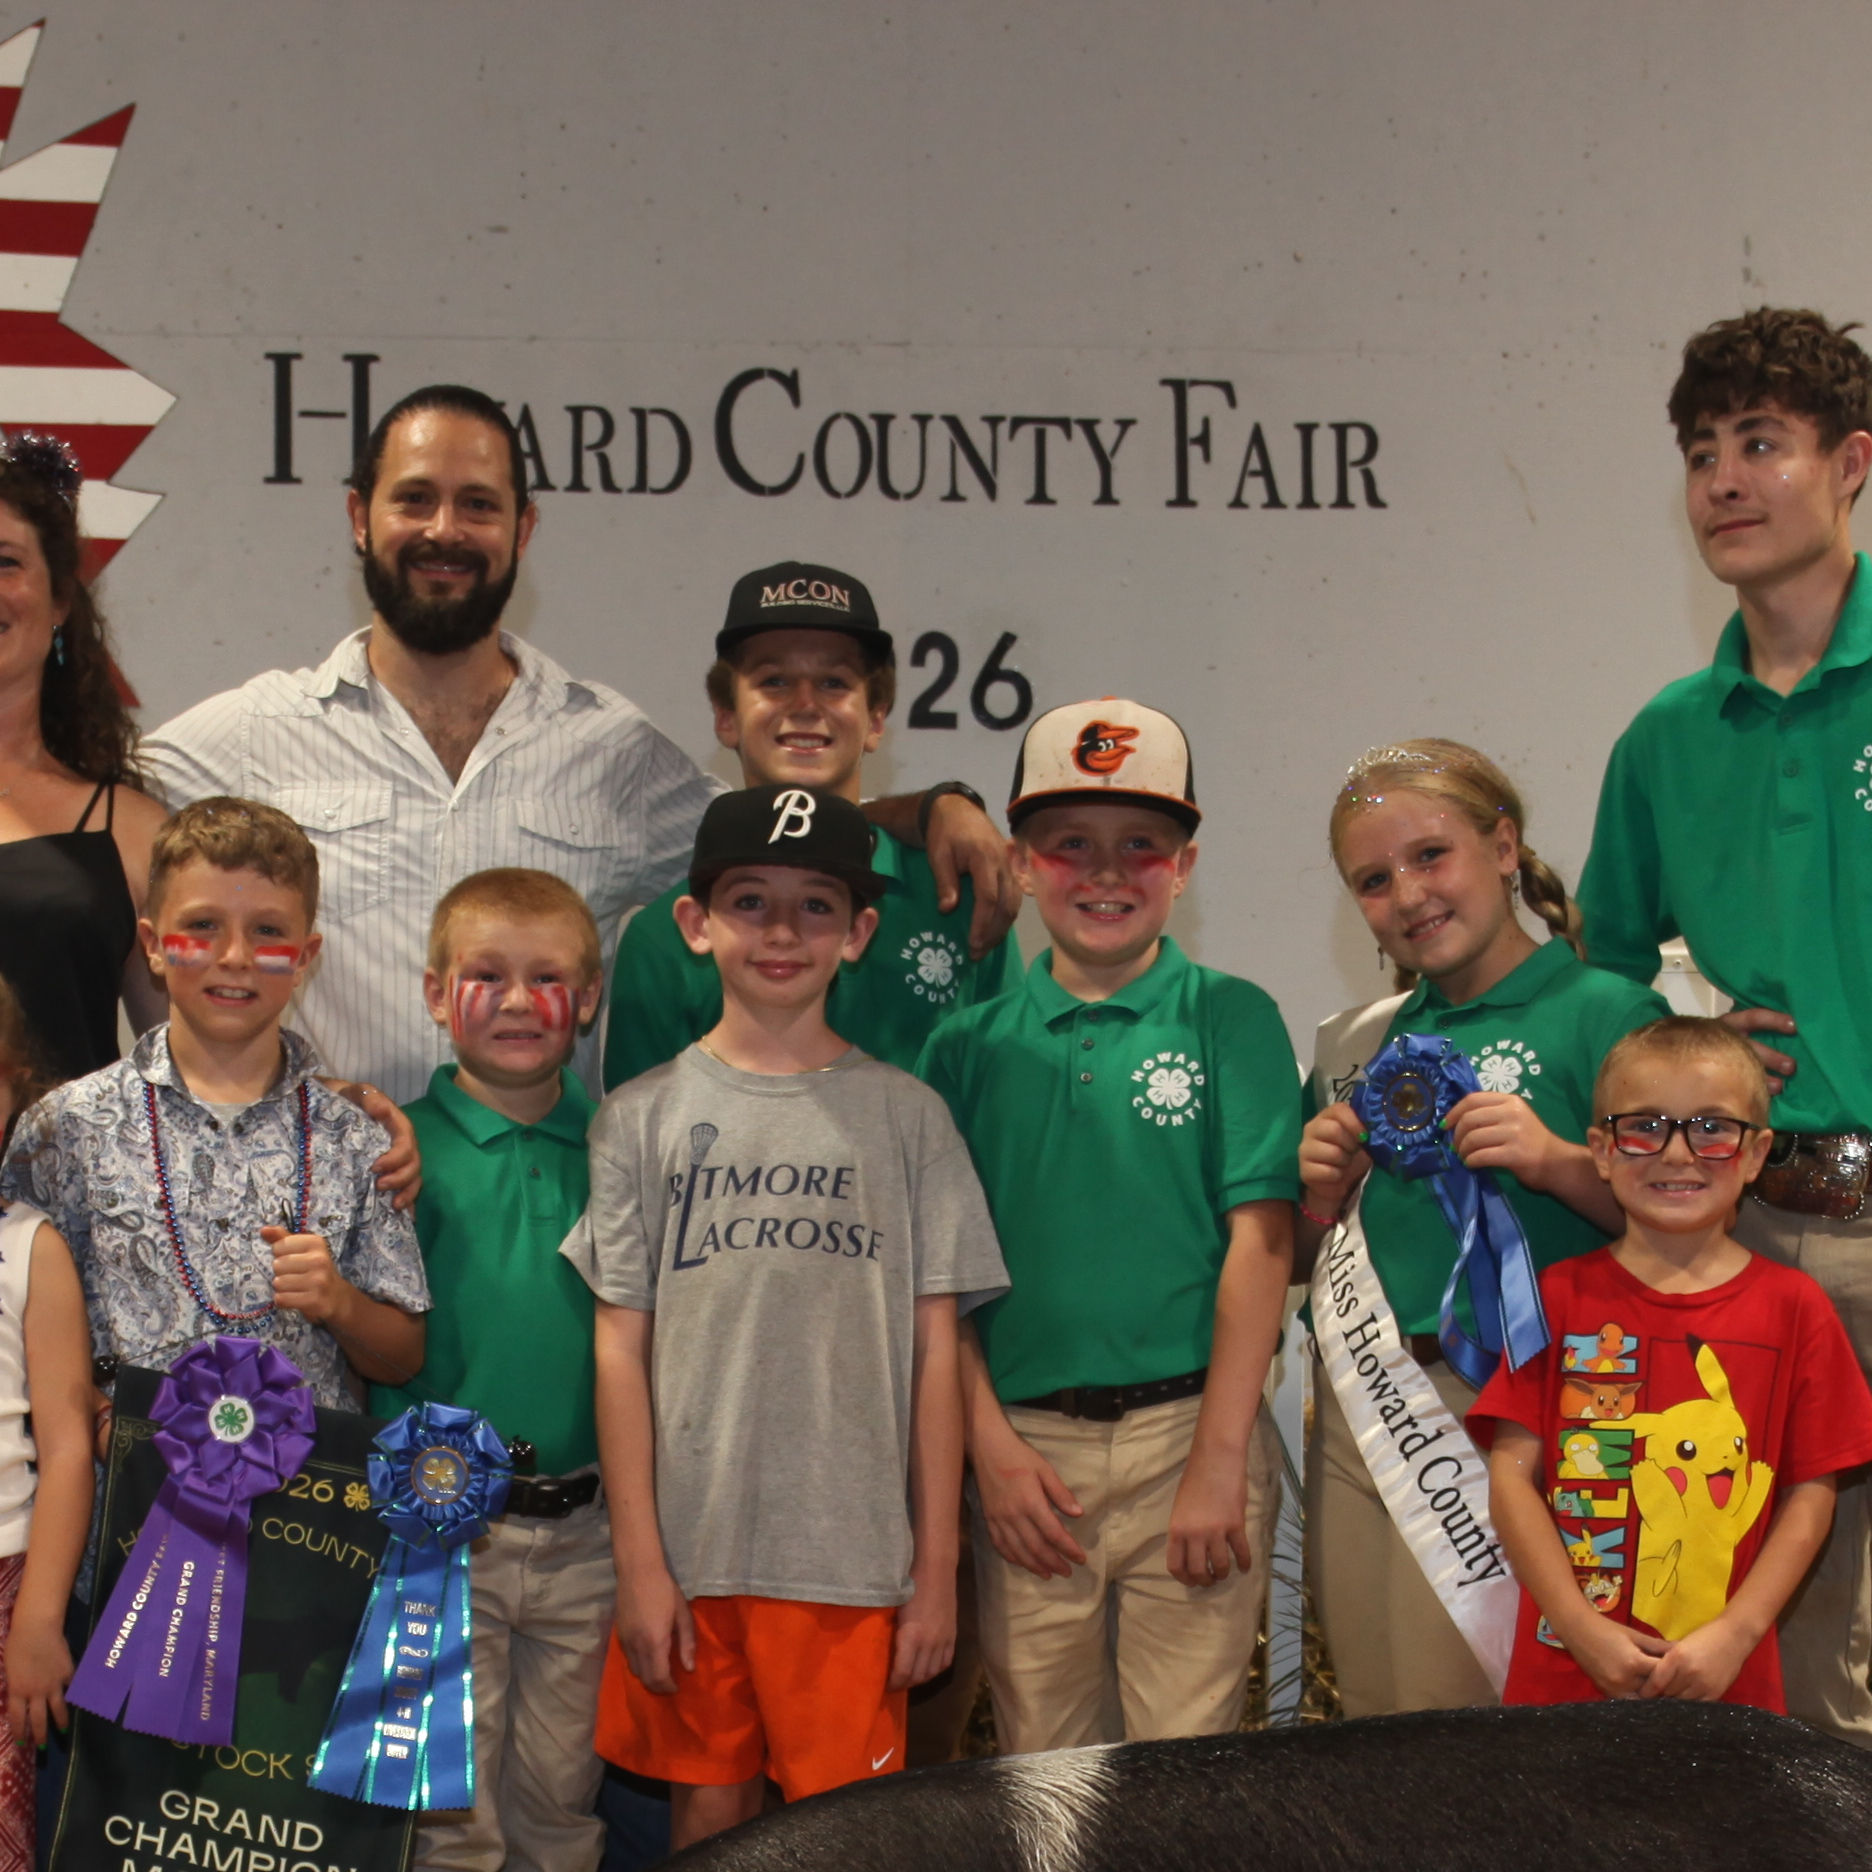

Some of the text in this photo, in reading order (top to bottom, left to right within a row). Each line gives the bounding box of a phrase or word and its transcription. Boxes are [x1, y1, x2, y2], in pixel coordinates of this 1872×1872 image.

[264, 352, 1388, 509] HARD COUNTY FAIR
[760, 579, 850, 607] MCON
[907, 631, 1033, 731] 26
[768, 790, 816, 845] B
[1131, 1052, 1205, 1086] HOWARD
[1132, 1098, 1202, 1126] COUNTY
[673, 1185, 885, 1271] LACROSSE
[1327, 1228, 1507, 1588] Miss Howard County
[275, 1474, 335, 1503] 26
[262, 1518, 380, 1579] COUNTY
[104, 1560, 161, 1669] HOWARD COUNTY
[159, 1561, 195, 1677] GRAND CHAMPION
[404, 1600, 437, 1617] THANK
[407, 1621, 428, 1636] YOU
[200, 1649, 217, 1721] MARYLAND
[159, 1790, 324, 1852] GRAND
